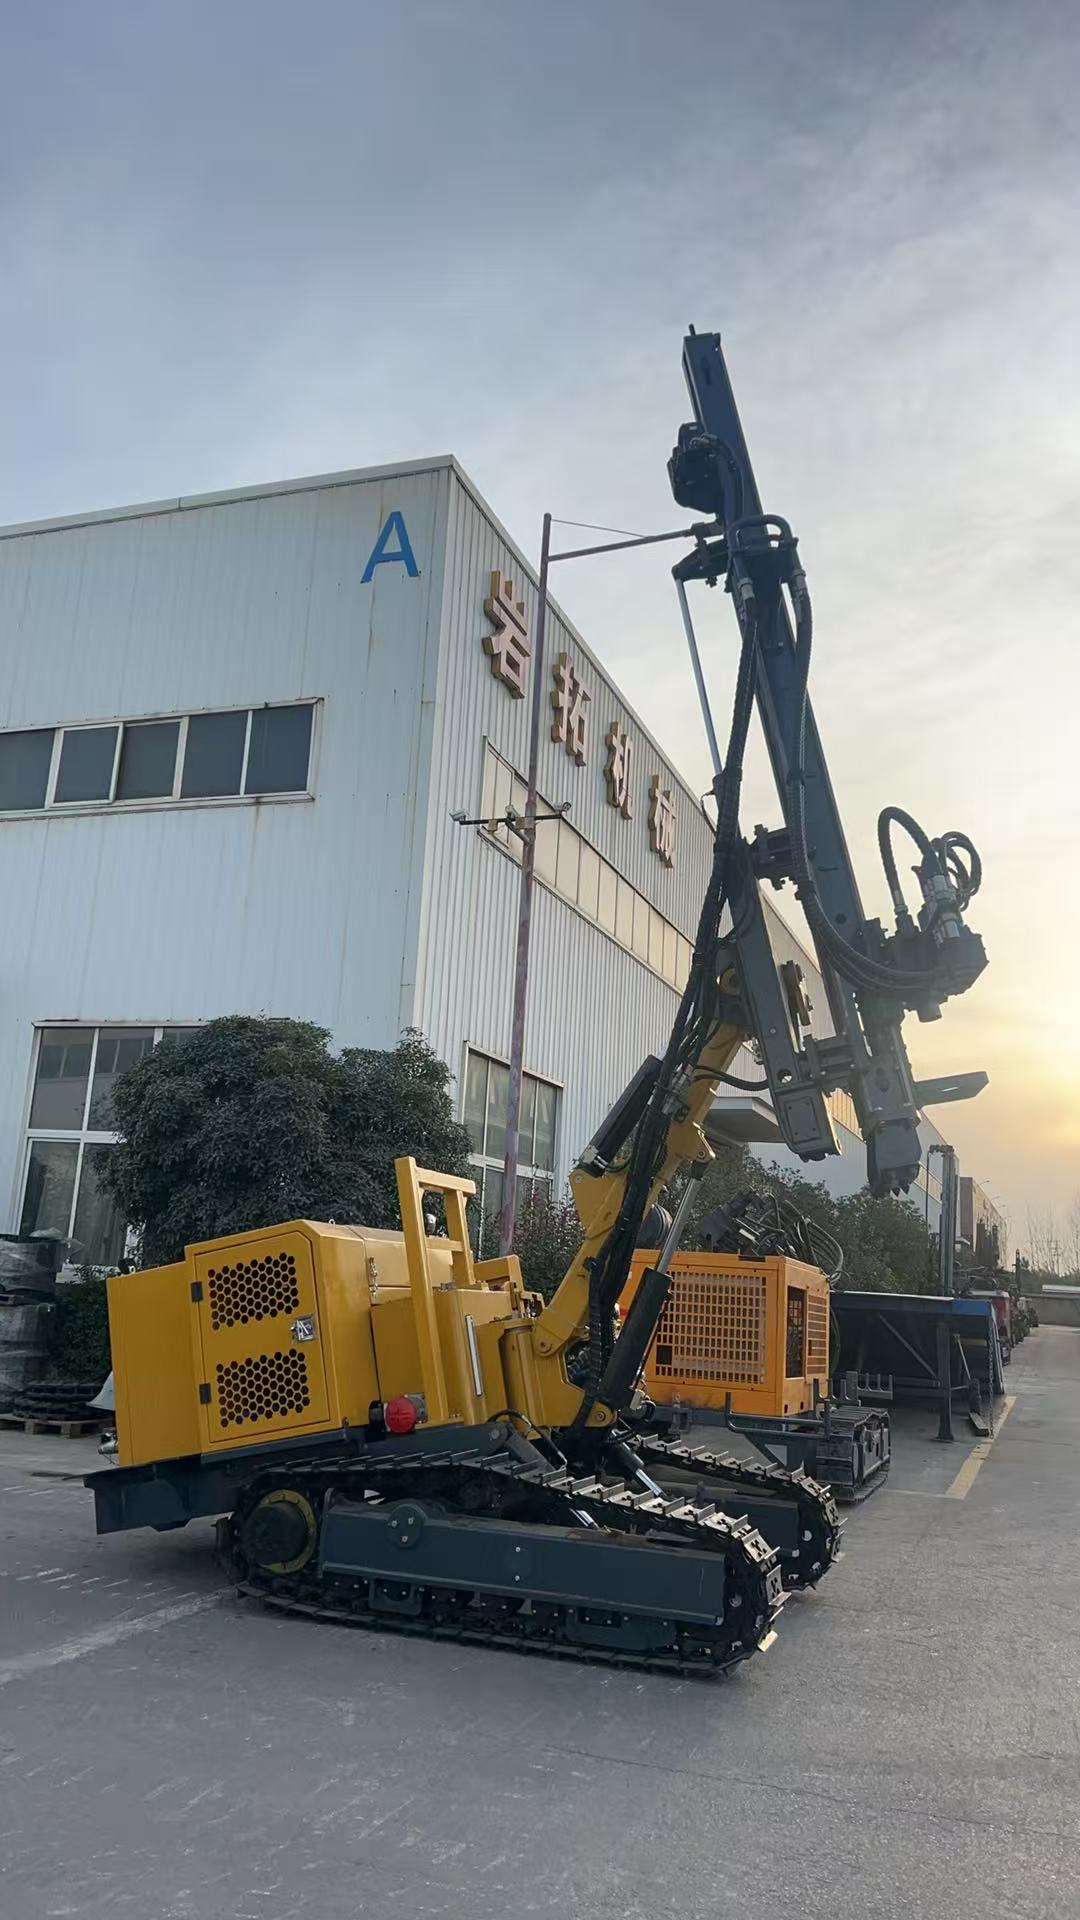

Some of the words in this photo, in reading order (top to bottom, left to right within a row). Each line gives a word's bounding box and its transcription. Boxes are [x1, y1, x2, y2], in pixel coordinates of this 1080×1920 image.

[360, 511, 418, 583] A
[482, 570, 677, 868] 岩拓机械
